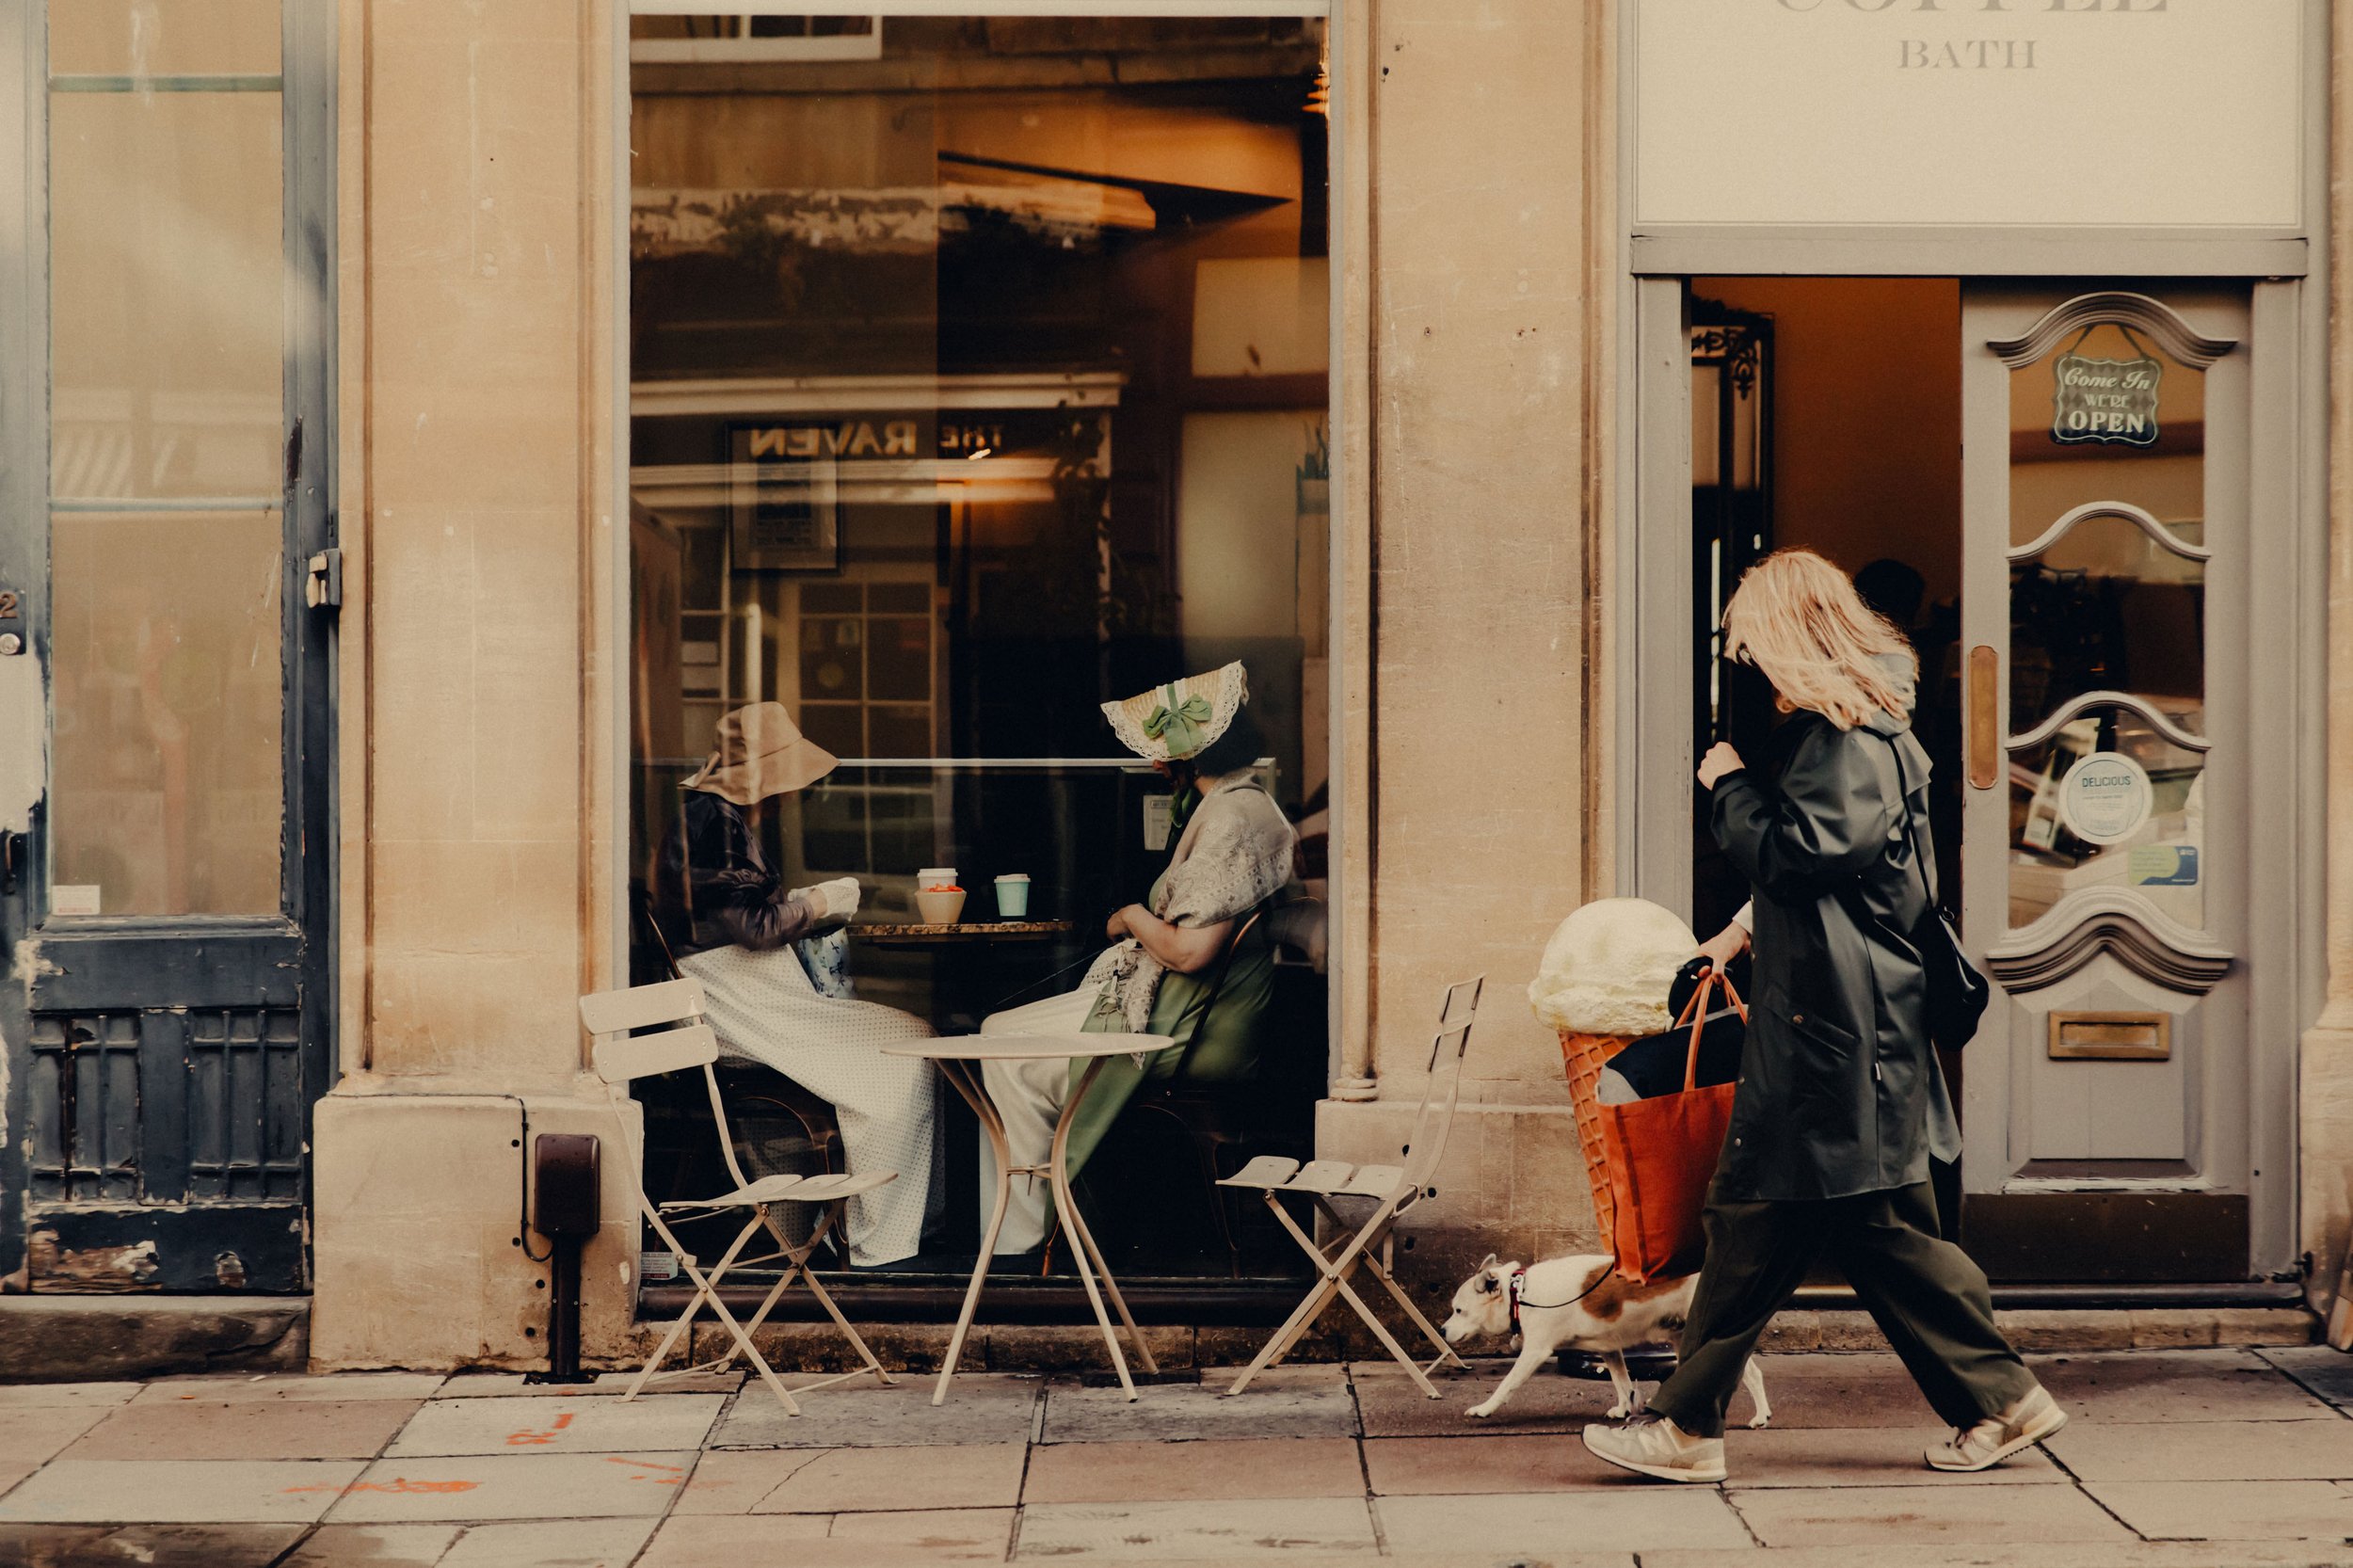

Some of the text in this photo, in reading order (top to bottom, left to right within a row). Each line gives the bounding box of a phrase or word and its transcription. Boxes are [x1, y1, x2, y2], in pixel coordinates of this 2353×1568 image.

[1897, 40, 2038, 69] BATH
[2065, 367, 2151, 390] Come In
[2068, 410, 2145, 433] OPEN
[2082, 776, 2132, 788] DELICIOUS
